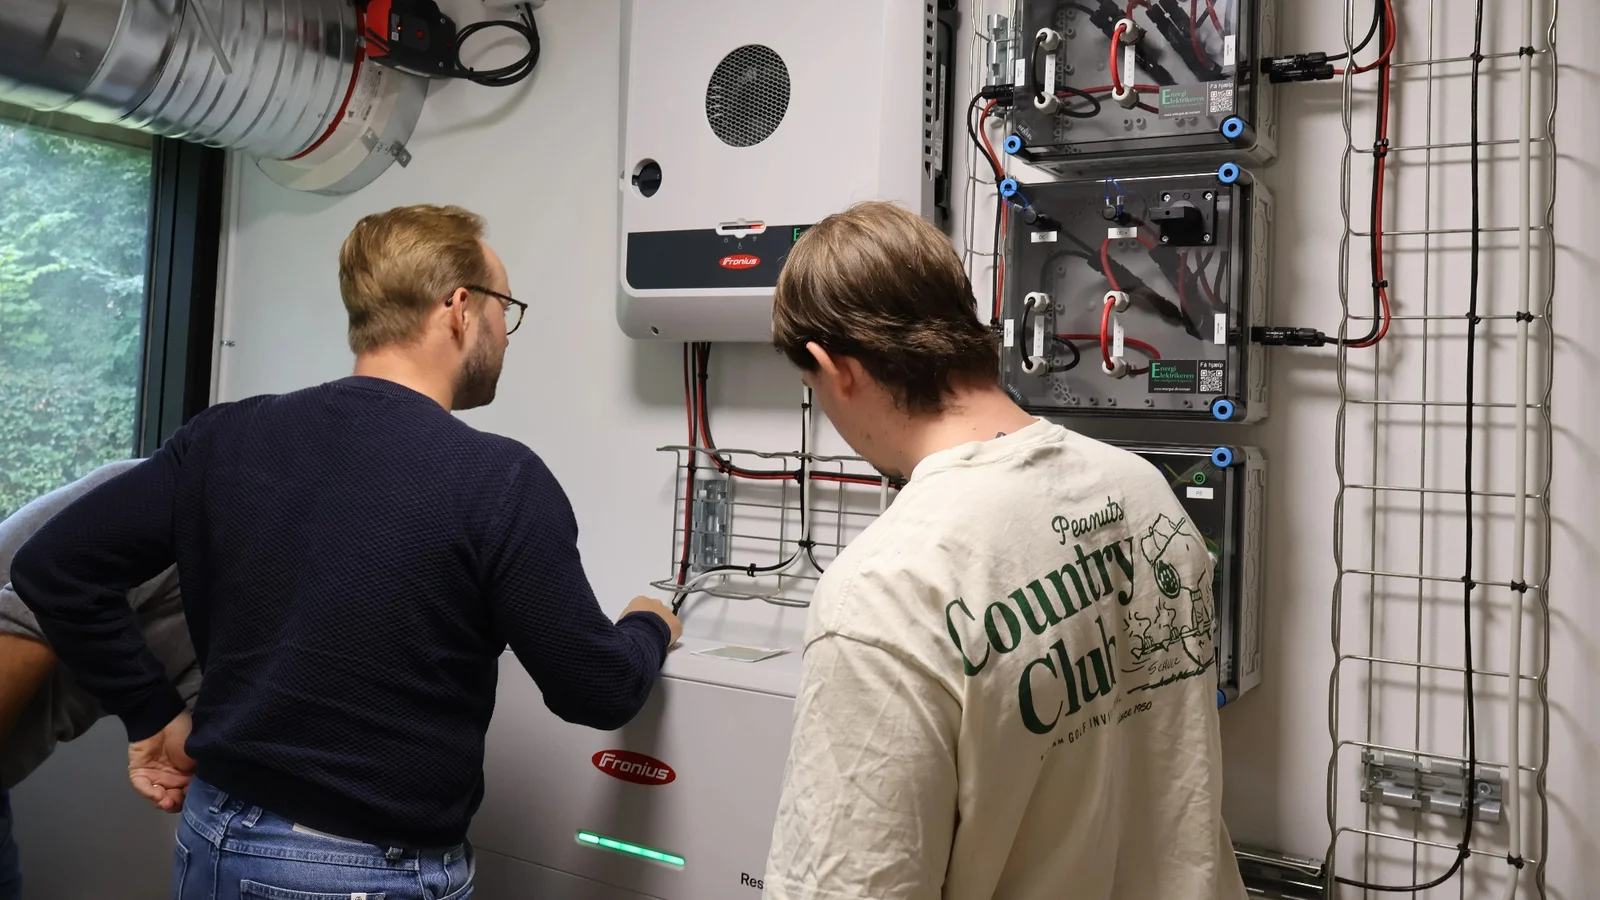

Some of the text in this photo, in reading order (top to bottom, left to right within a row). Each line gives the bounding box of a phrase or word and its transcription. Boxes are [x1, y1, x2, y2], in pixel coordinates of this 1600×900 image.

[722, 257, 757, 266] Fronius
[1152, 371, 1195, 379] Elektrikeren
[1052, 496, 1124, 545] Peanuts
[945, 536, 1135, 677] Country
[1134, 701, 1152, 714] 1950
[1068, 722, 1086, 744] GOLF
[599, 753, 670, 781] Fronius
[741, 872, 763, 890] Res
